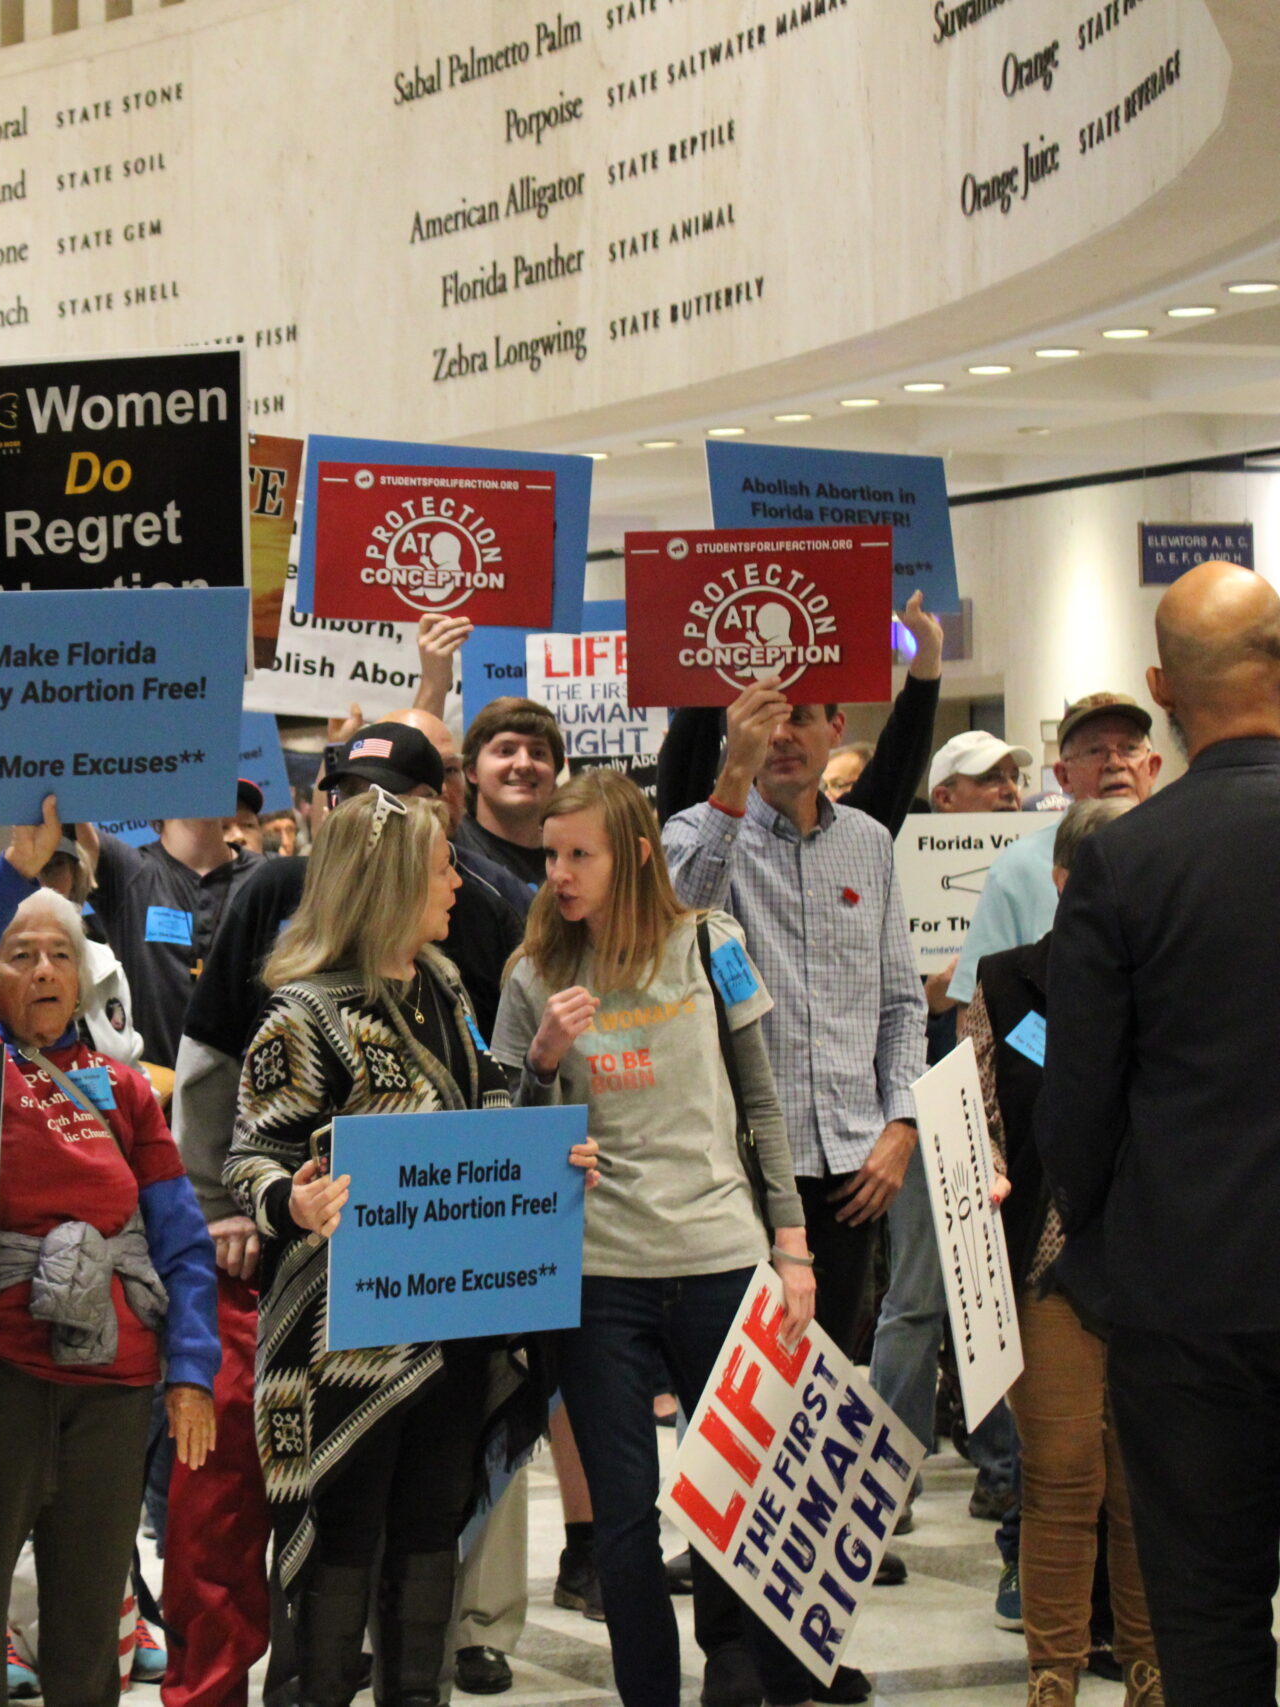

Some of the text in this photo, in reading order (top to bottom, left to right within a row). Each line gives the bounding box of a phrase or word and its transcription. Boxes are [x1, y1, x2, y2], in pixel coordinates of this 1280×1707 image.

[607, 0, 657, 30] STATE
[1078, 0, 1120, 50] STATE
[394, 12, 582, 106] Sabal Palmetto Palm
[607, 0, 848, 107] STATE SALTWATER MAMMAL
[1002, 39, 1060, 98] Orange
[56, 83, 184, 128] STATE STONE
[505, 90, 584, 145] Porpoise
[1079, 49, 1181, 154] STATE BEVERAGE
[57, 153, 167, 191] STATE SOIL
[608, 120, 736, 184] STATE REPTILE
[960, 135, 1060, 217] Orange Juice
[410, 171, 586, 244] American Alligator
[57, 219, 163, 254] STATE GEM
[609, 203, 736, 263] STATE ANIMAL
[441, 243, 585, 308] Florida Panther
[58, 281, 180, 319] STATE SHELL
[609, 276, 766, 340] STATE BUTTERFLY
[255, 325, 298, 348] FISH
[432, 320, 587, 382] Zebra Longwing
[26, 385, 228, 435] Women
[64, 450, 132, 495] Do
[380, 475, 519, 490] STUDENTSFORLIFEACTION.ORG
[741, 478, 916, 505] Abolish Abortion in
[5, 499, 183, 564] Regret
[366, 496, 502, 562] PROTECTION
[751, 502, 911, 527] Florida FOREVER!
[401, 532, 431, 553] AT
[696, 539, 853, 554] STUDENTSFORLIFEACTION.ORG
[1147, 535, 1208, 548] ELEVATORS
[360, 568, 505, 590] CONCEPTION
[683, 563, 836, 639] PROTECTION
[724, 605, 756, 629] AT
[66, 641, 157, 667] Florida
[678, 645, 840, 667] CONCEPTION
[20, 677, 139, 705] Abortion
[141, 676, 207, 701] Free!
[542, 684, 582, 701] THE
[918, 836, 984, 851] Florida
[910, 917, 941, 933] For
[586, 1048, 653, 1075] TO BE
[591, 1068, 657, 1097] BORN
[398, 1158, 521, 1189] Make Florida
[354, 1192, 558, 1230] Totally Abortion Free!
[961, 1086, 1007, 1352] For The Unborn
[933, 1132, 976, 1366] Florida Voice
[407, 1272, 457, 1296] More
[670, 1284, 812, 1555] LIFE
[733, 1352, 840, 1581] THE FIRST
[762, 1384, 875, 1622] HUMAN
[799, 1422, 912, 1667] RIGHT
